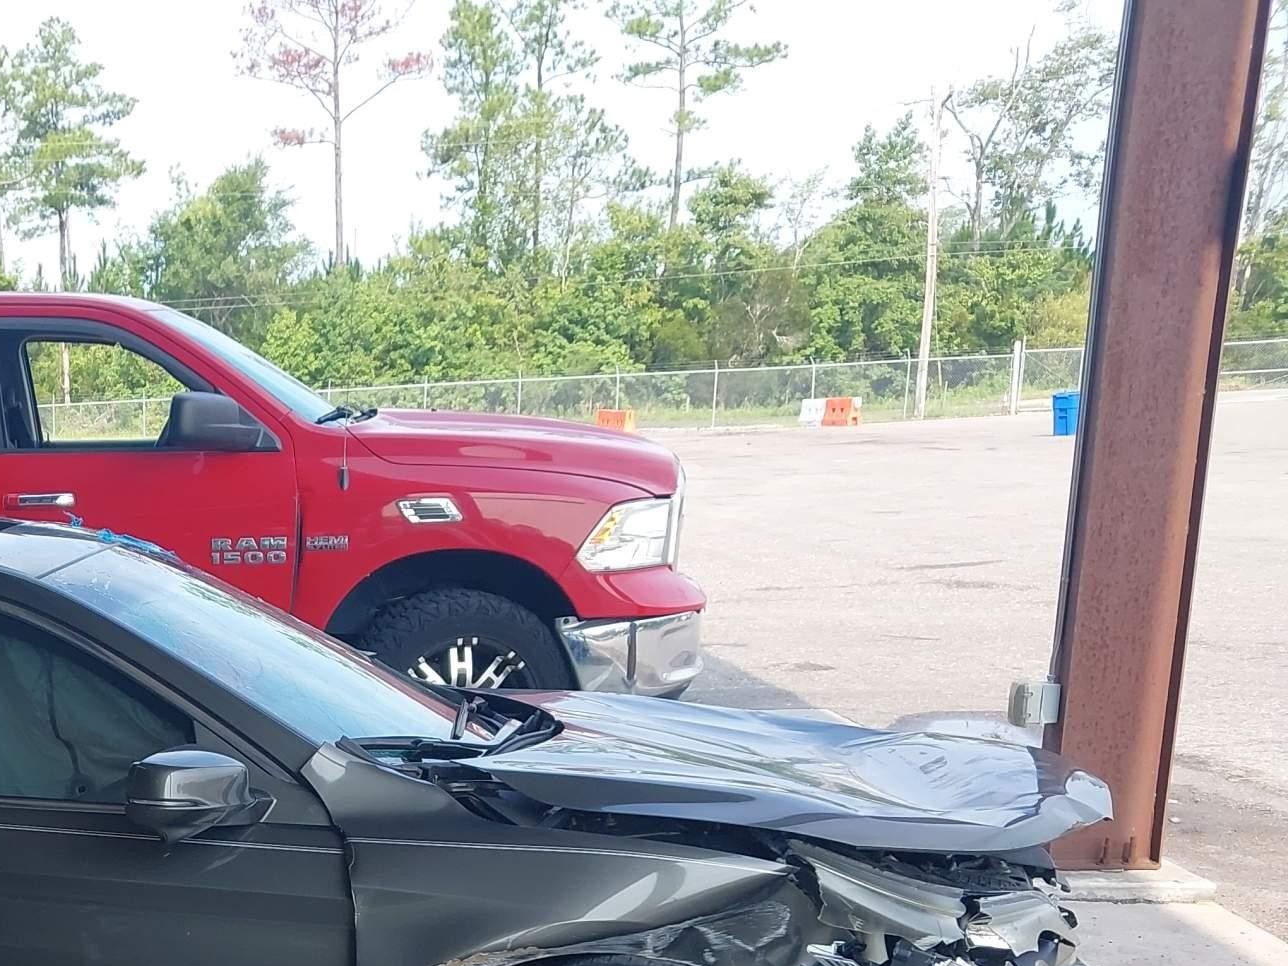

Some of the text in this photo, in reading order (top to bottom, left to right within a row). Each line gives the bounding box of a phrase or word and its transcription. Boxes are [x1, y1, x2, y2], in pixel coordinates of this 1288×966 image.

[211, 536, 288, 552] RAM
[306, 535, 349, 545] HEMI
[210, 551, 287, 565] 1500
